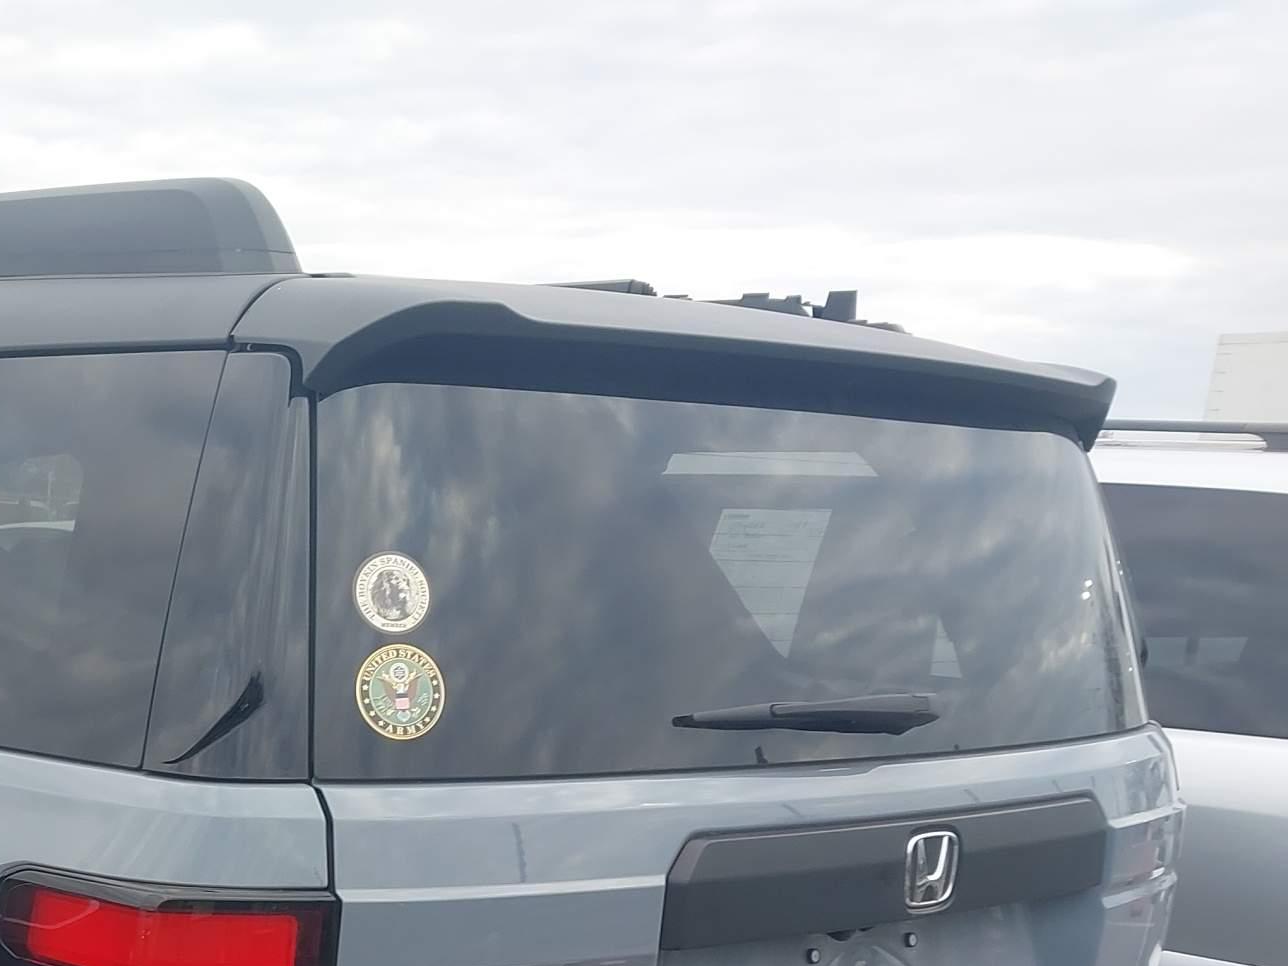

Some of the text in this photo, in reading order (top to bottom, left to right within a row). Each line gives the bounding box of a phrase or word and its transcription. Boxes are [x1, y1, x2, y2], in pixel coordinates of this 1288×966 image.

[378, 556, 420, 577] SPANIEL
[362, 648, 436, 681] UNITED STATES
[385, 721, 425, 735] ARMY
